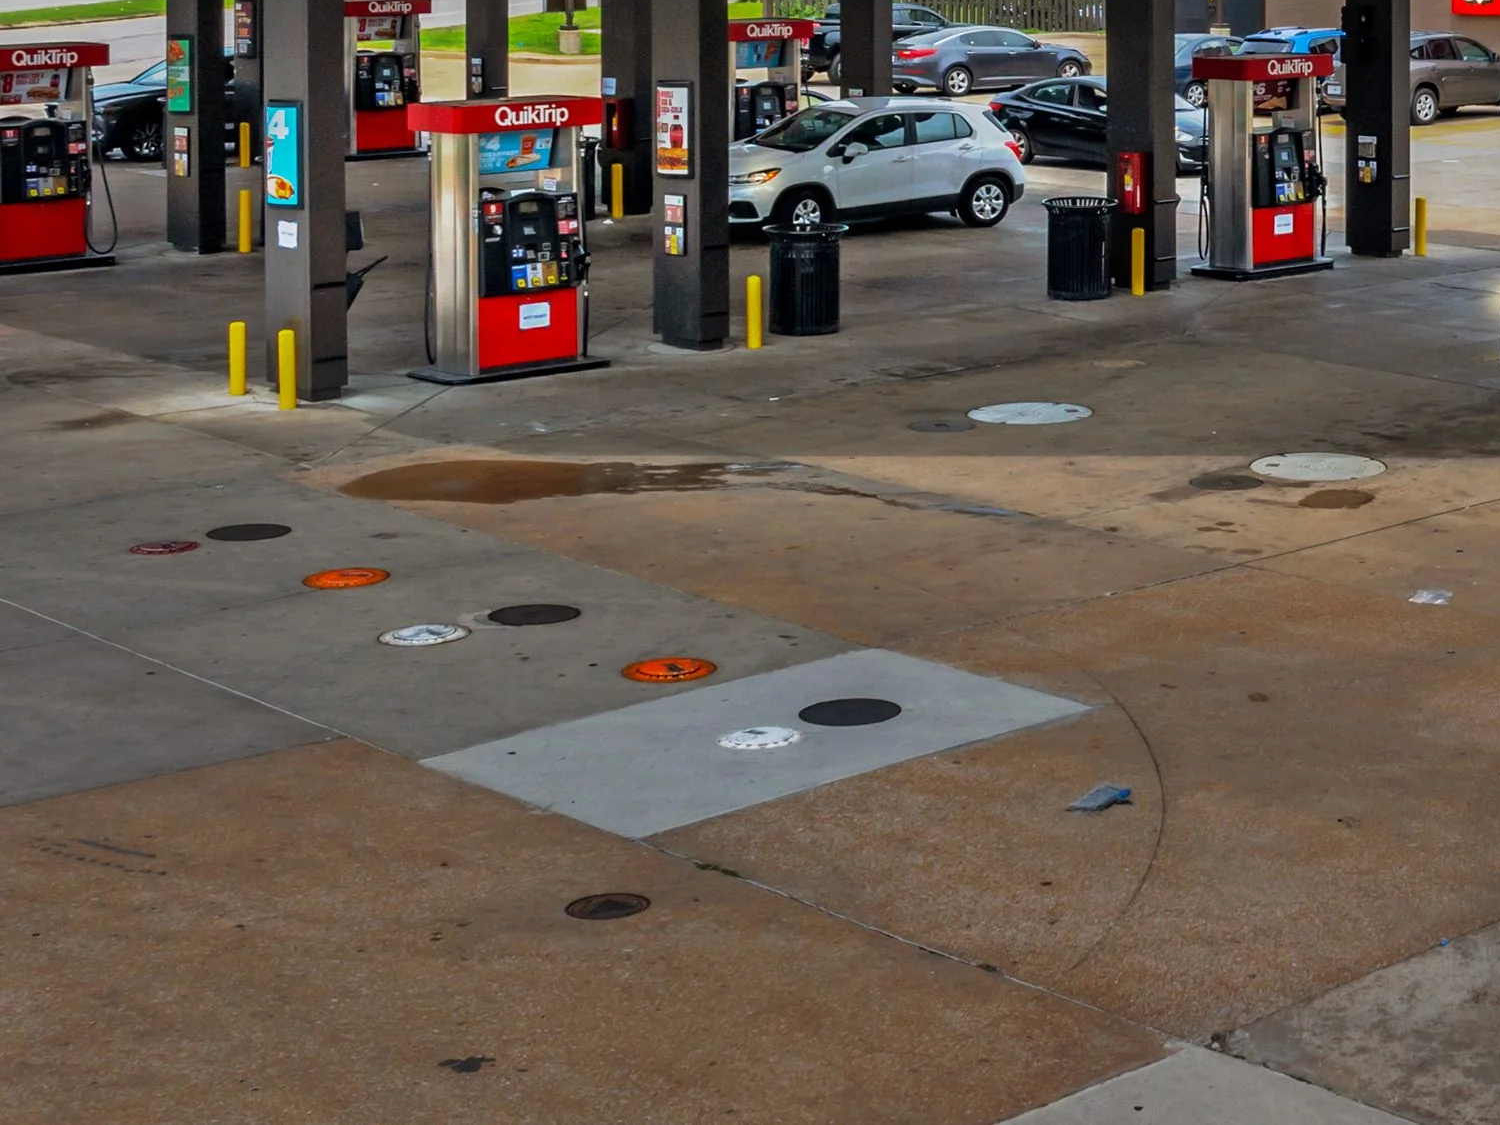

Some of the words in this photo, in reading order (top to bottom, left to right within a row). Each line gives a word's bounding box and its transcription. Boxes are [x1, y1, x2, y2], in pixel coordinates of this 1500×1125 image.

[368, 1, 412, 14] QuikTrip
[747, 24, 793, 37] QuikTrip
[12, 50, 79, 66] QuikTrip
[1267, 59, 1313, 76] QuikTrip
[495, 105, 569, 126] QuikTrip
[269, 110, 289, 139] 4
[490, 203, 496, 212] 9
